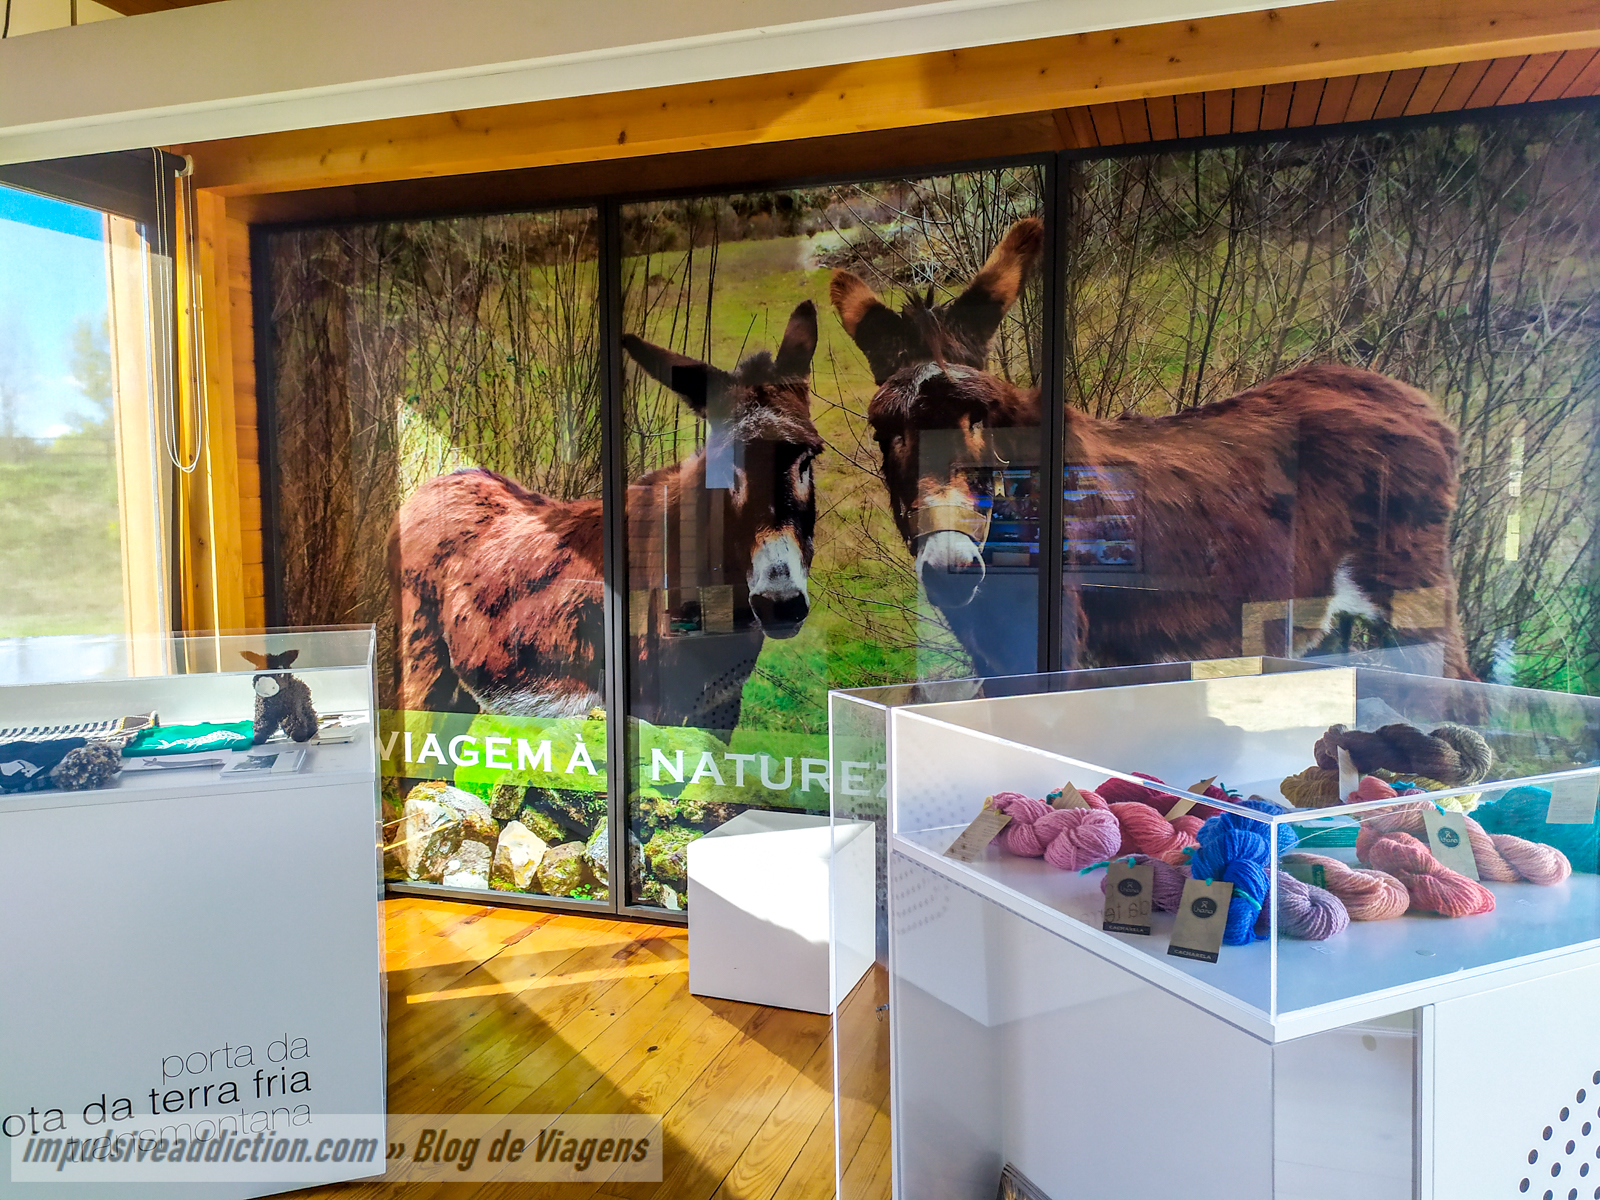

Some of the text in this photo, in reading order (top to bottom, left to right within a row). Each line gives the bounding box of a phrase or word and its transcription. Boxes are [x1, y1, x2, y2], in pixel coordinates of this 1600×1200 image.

[375, 730, 553, 773] VIAGEM
[565, 733, 599, 776] À
[162, 1033, 310, 1085] porta da
[82, 1093, 135, 1126] da
[148, 1080, 240, 1115] terra
[252, 1067, 311, 1099] fria
[67, 1104, 313, 1163] transmontana
